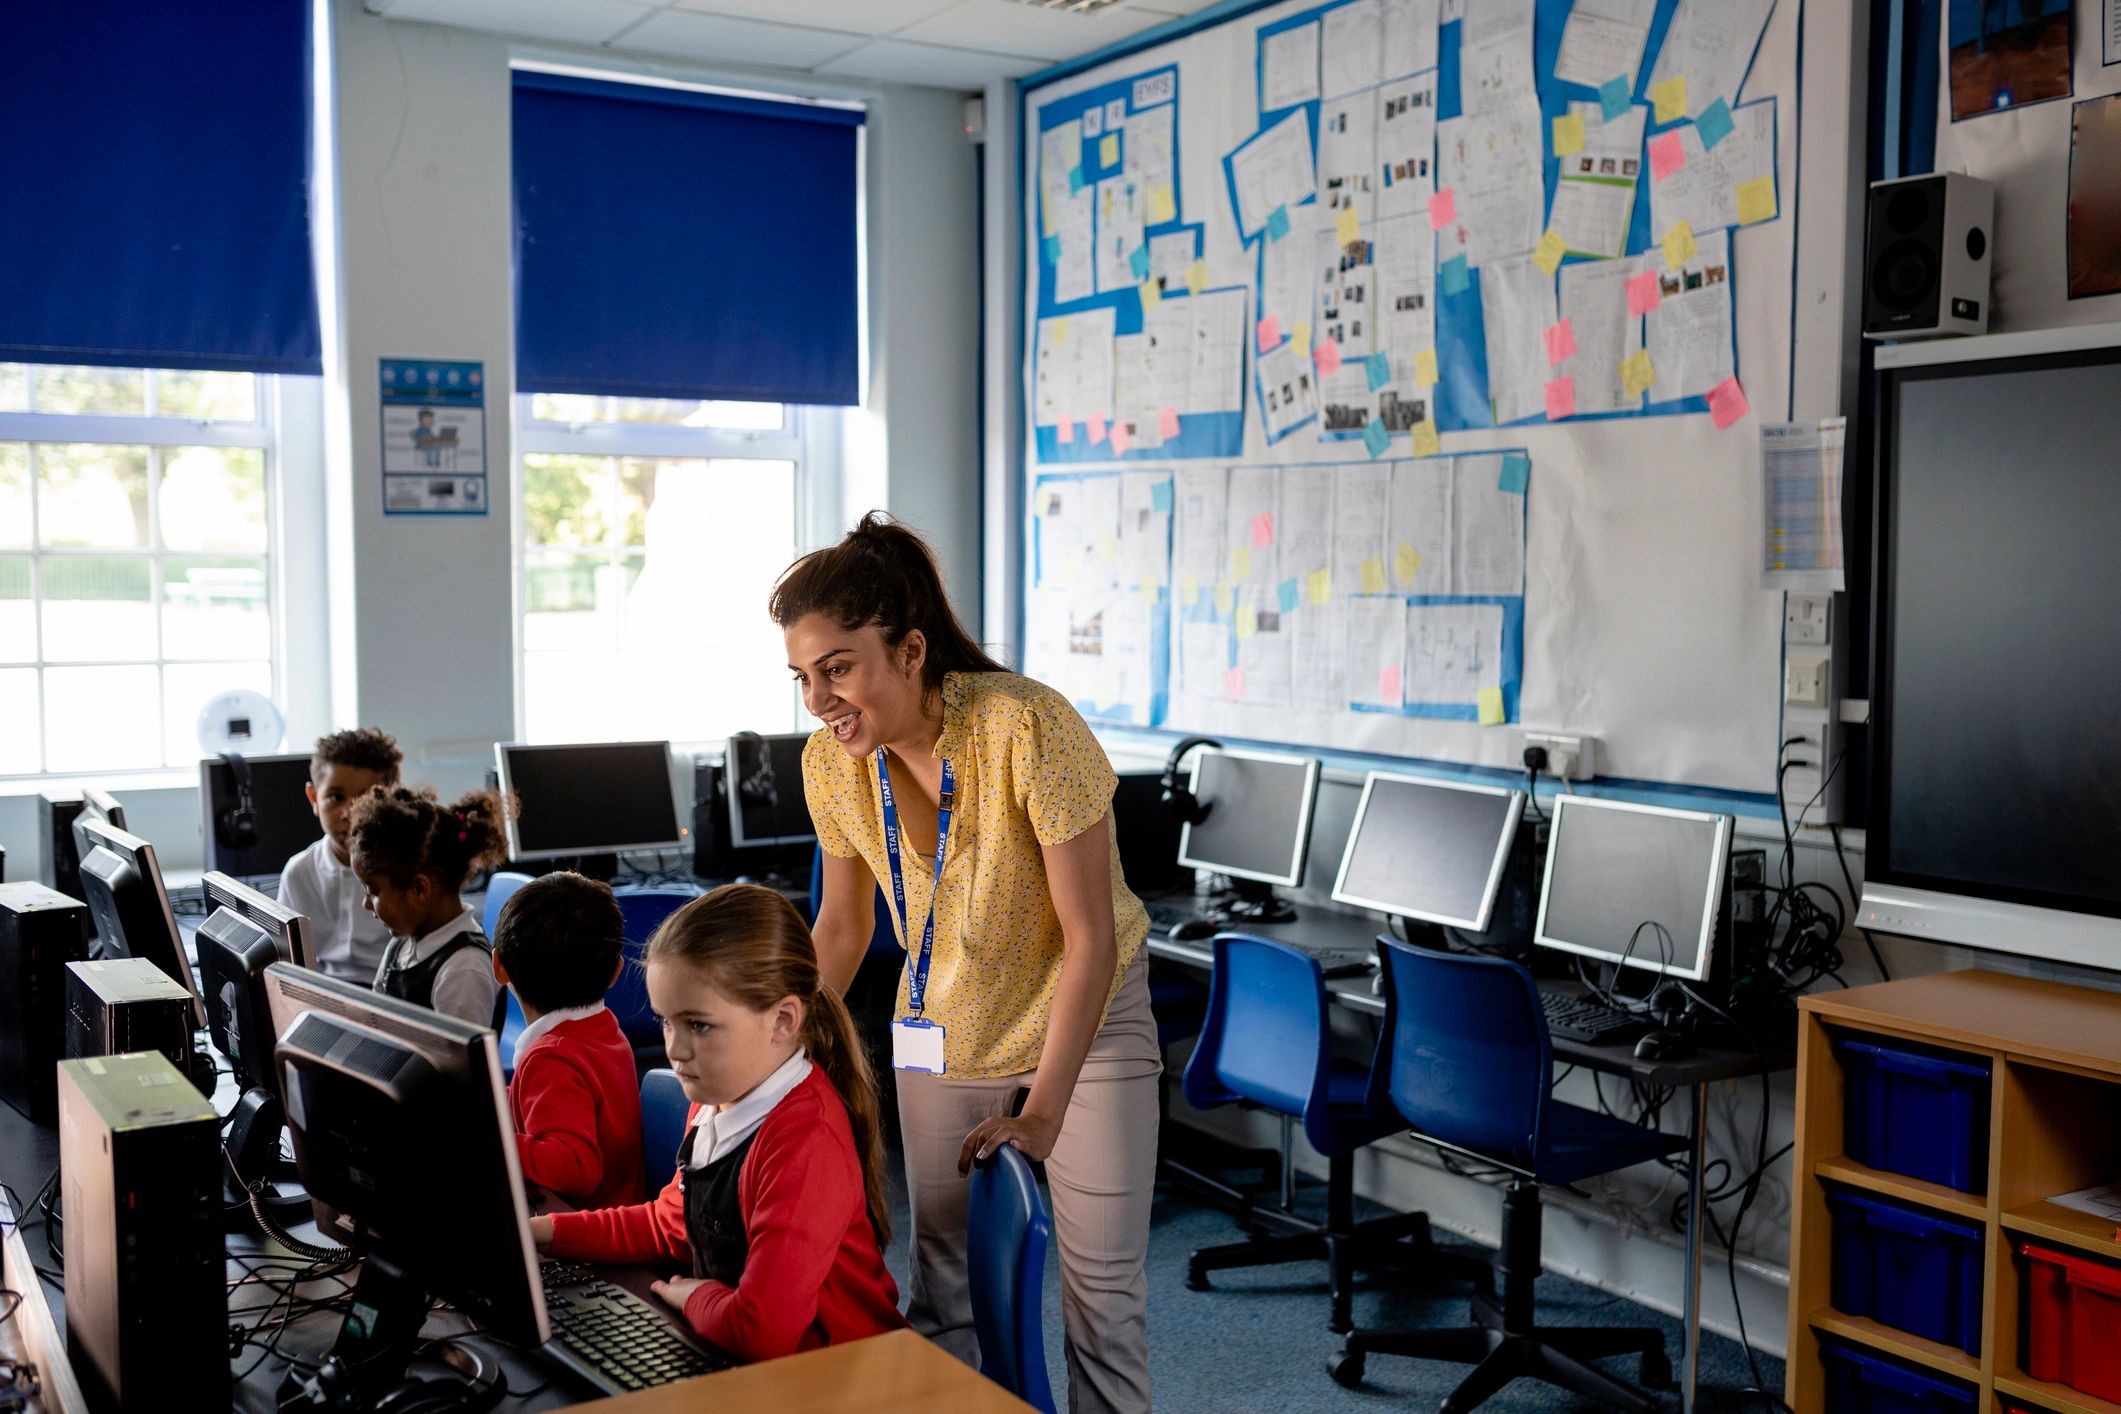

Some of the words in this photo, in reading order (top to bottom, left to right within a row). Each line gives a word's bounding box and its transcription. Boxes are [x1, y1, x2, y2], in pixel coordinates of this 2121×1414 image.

[944, 759, 953, 780] AFF
[882, 778, 892, 807] STAFF
[888, 826, 898, 854] STAFF
[938, 832, 946, 862] STAFF
[894, 872, 903, 901] STAFF
[923, 926, 933, 955] STAFF
